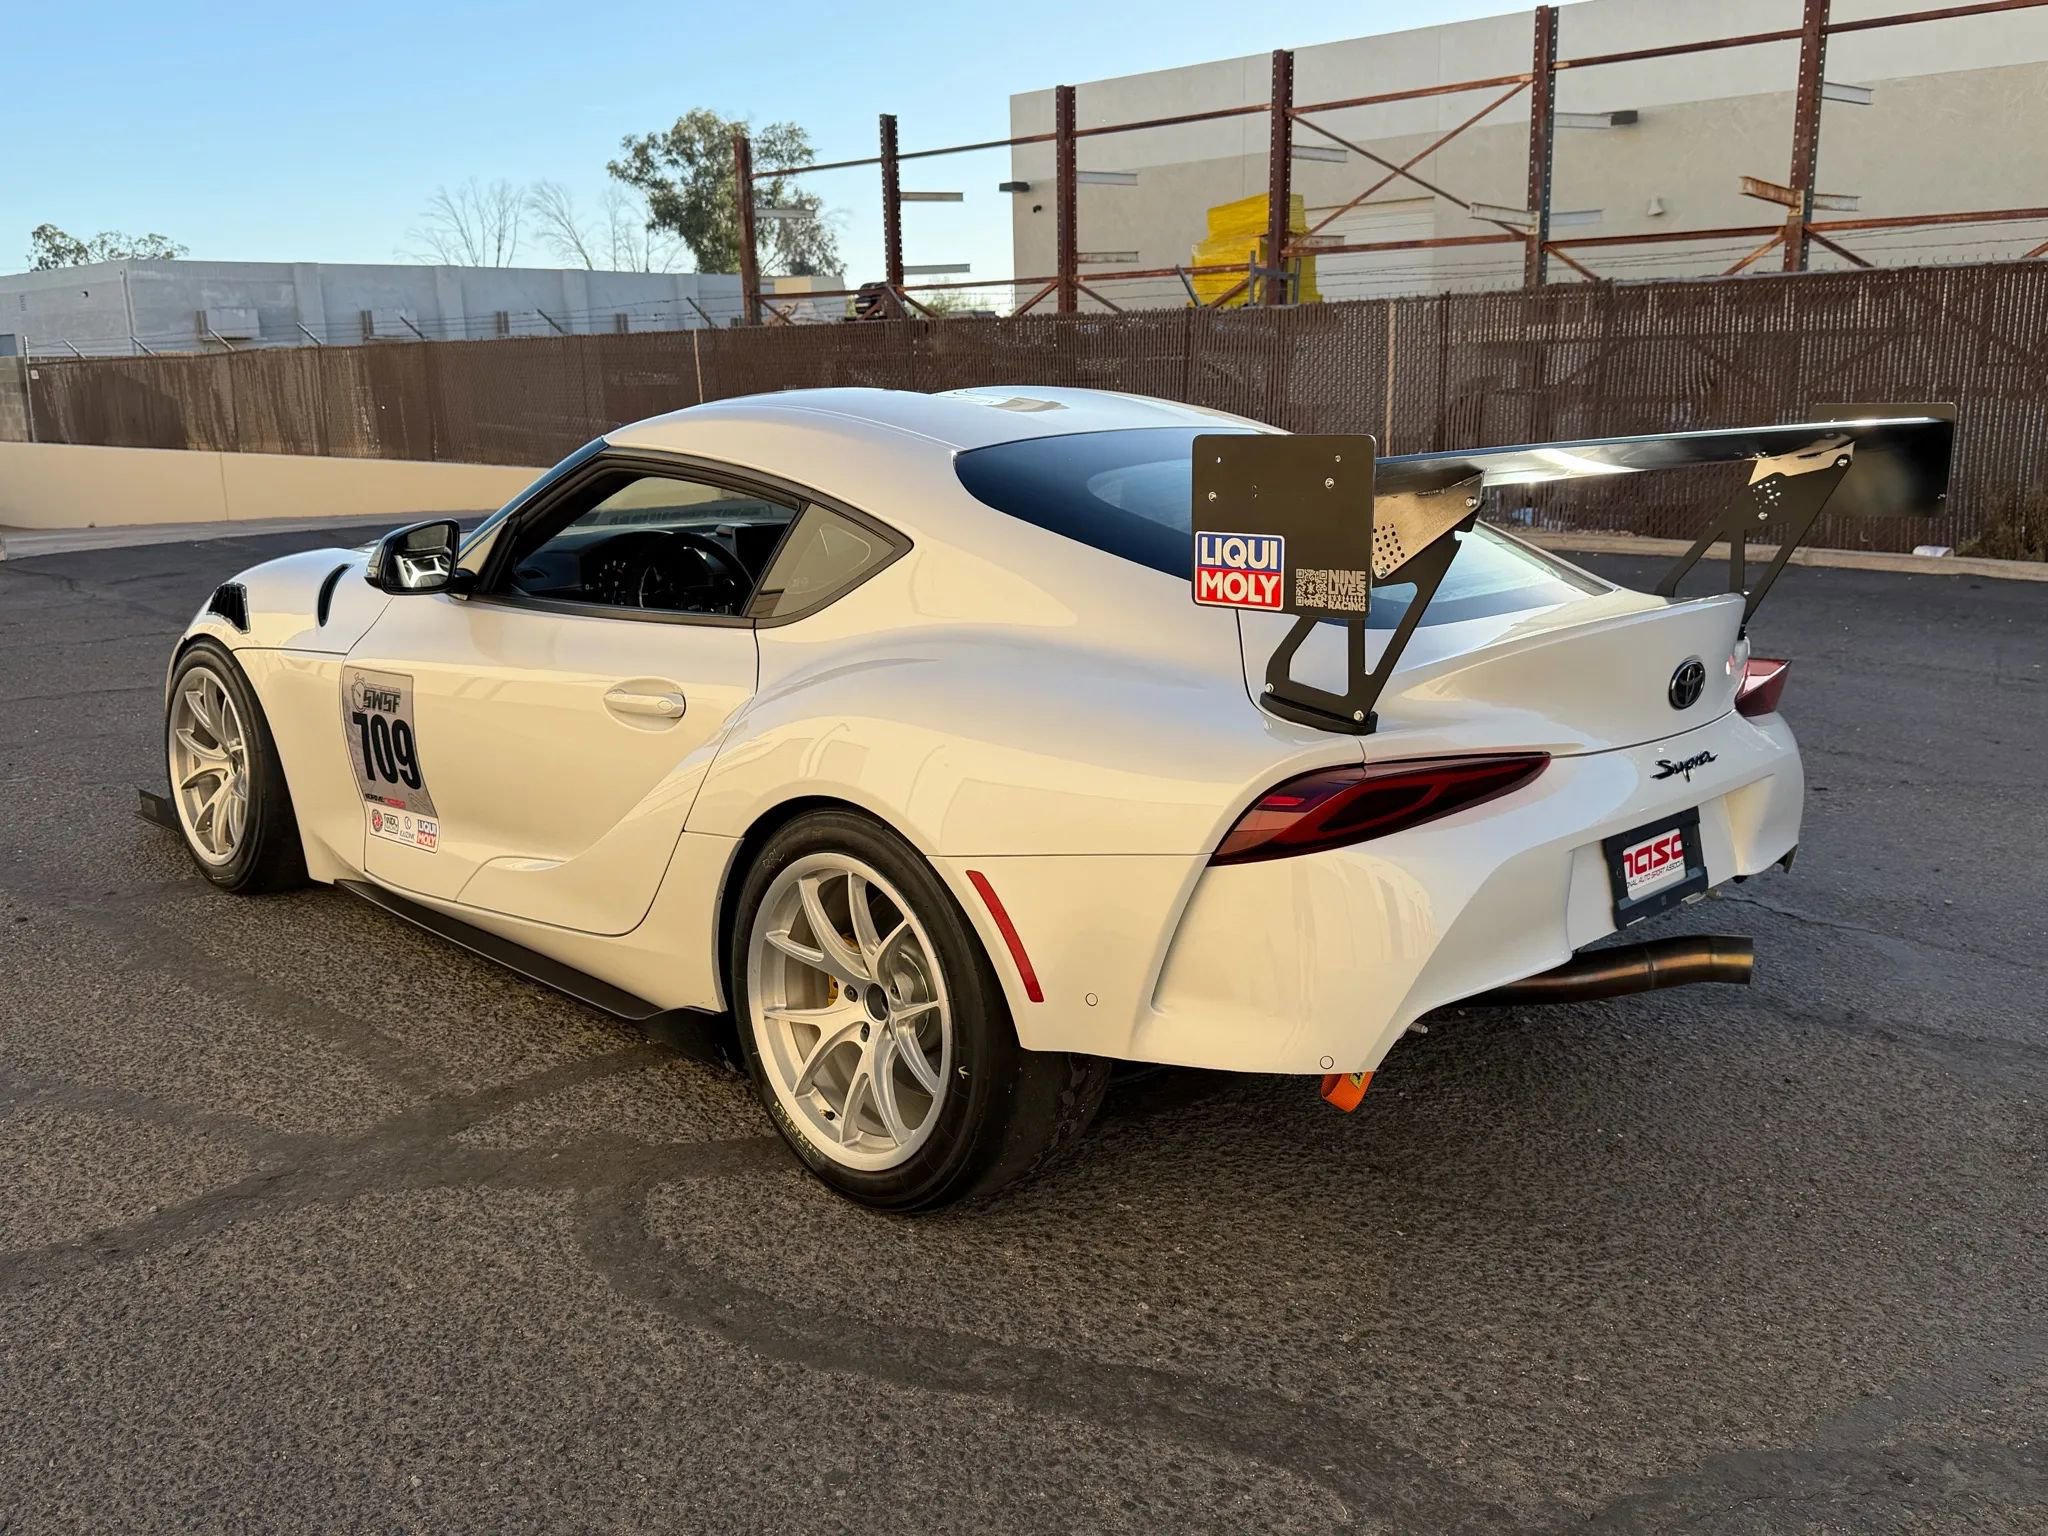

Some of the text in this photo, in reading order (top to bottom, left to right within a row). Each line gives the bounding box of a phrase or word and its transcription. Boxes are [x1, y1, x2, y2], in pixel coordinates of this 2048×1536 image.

[1201, 537, 1278, 569] LIQUI
[1201, 571, 1280, 603] MOLY
[1328, 569, 1366, 585] NINE
[1328, 582, 1366, 597] LIVES
[1327, 601, 1366, 612] RACING
[352, 711, 422, 790] 709
[1651, 750, 1718, 783] Supra
[417, 832, 436, 848] MOLY
